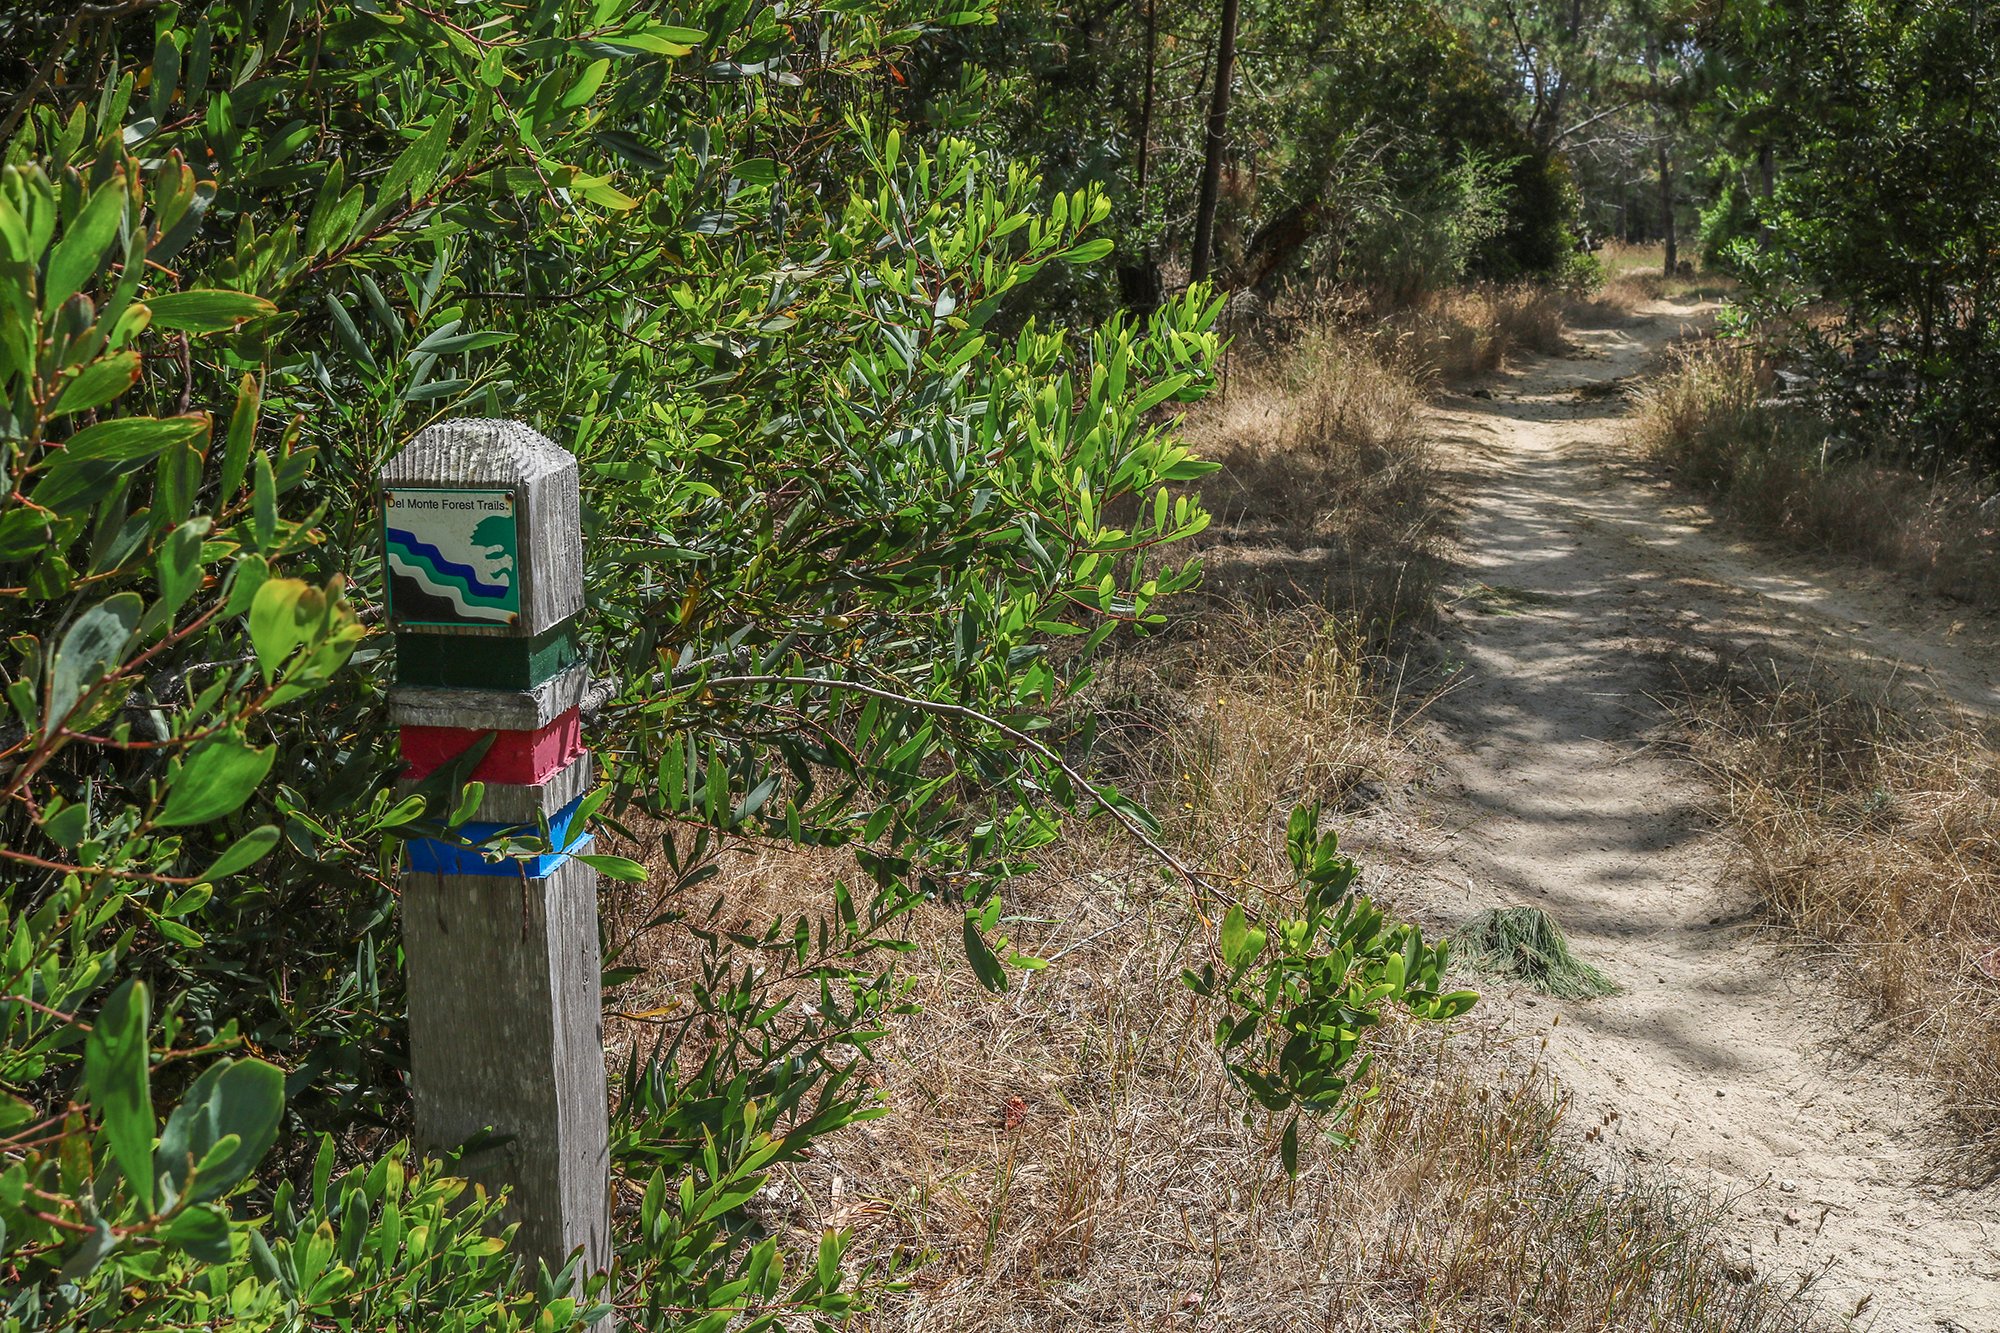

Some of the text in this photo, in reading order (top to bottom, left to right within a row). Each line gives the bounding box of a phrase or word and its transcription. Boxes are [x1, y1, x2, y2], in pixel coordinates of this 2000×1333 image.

[388, 498, 404, 508] Del
[408, 499, 439, 509] Monte
[442, 499, 475, 510] Forest
